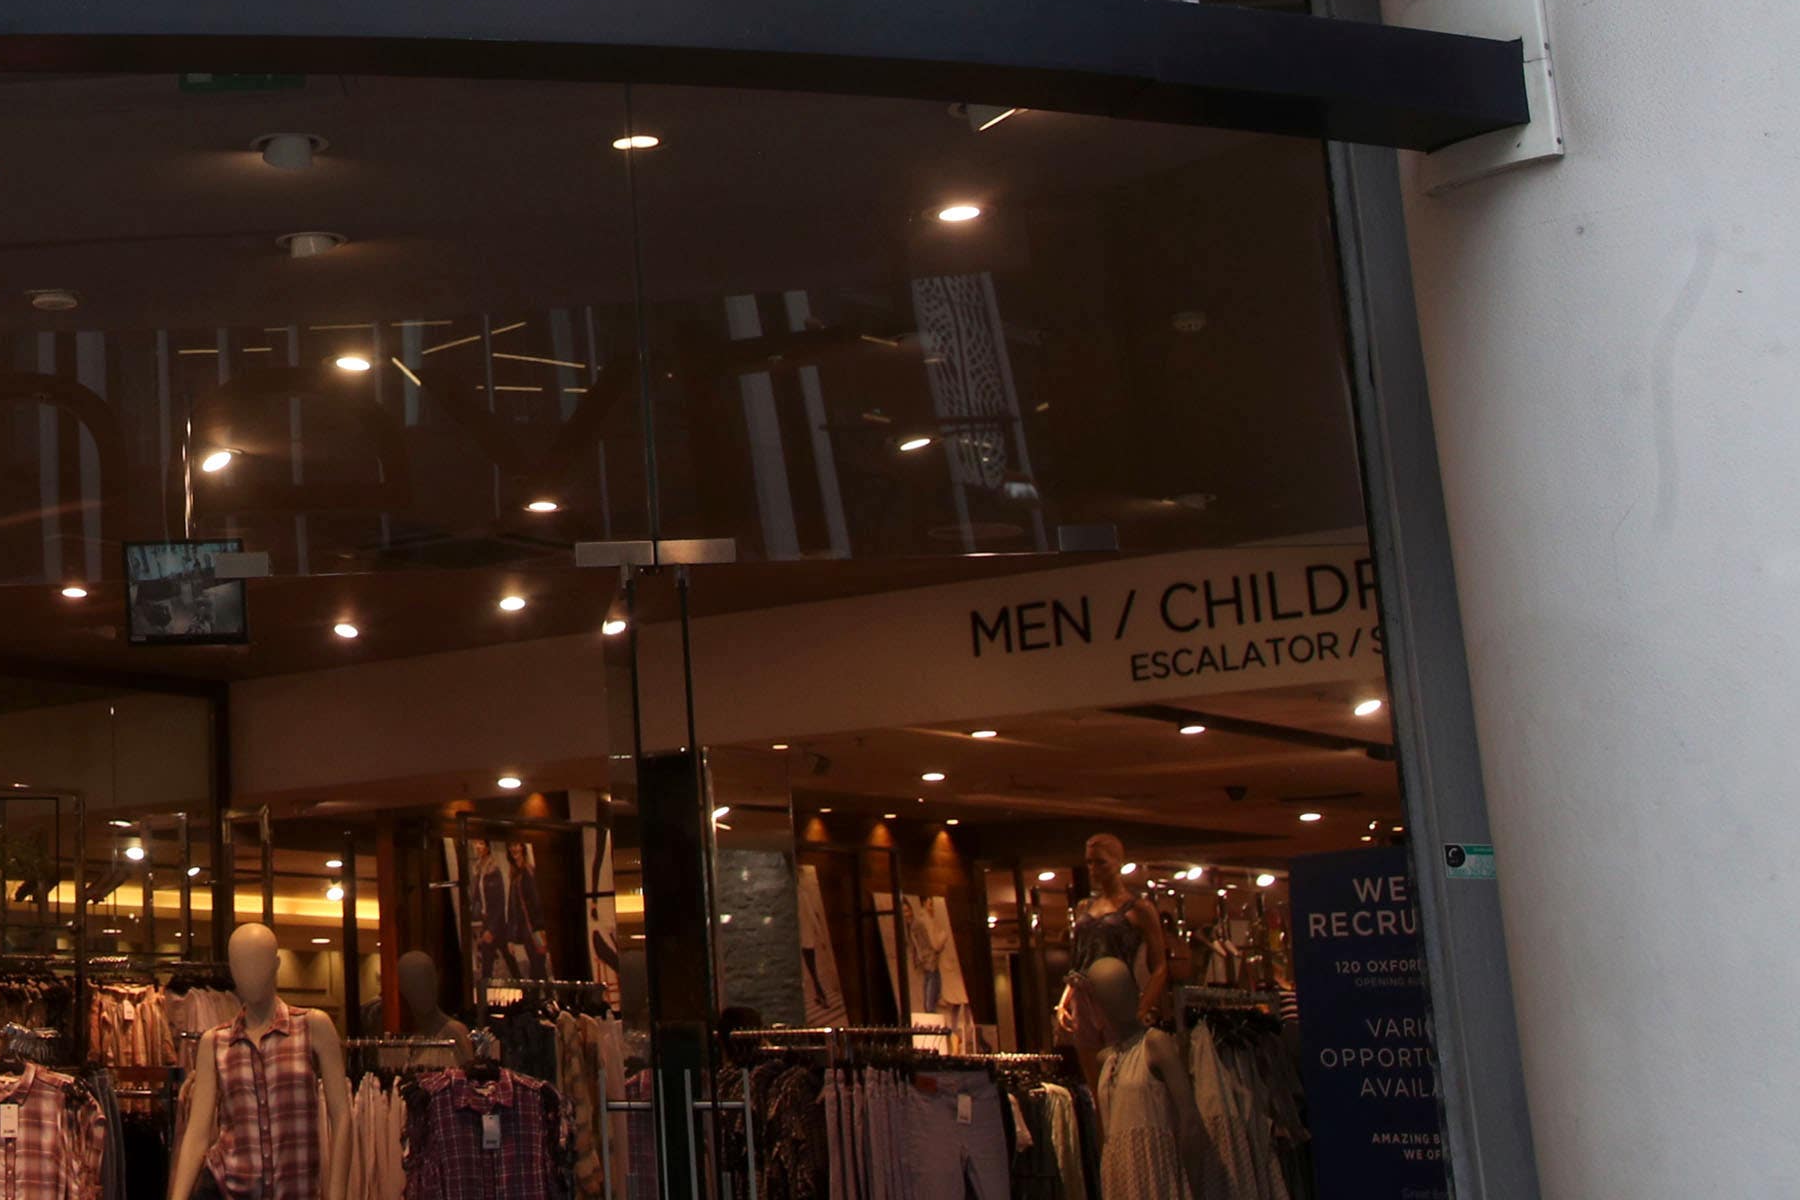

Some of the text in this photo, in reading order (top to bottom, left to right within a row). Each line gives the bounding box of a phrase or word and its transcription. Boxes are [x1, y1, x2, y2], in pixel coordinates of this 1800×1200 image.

[970, 596, 1091, 657] MEN
[1115, 589, 1136, 640] /
[1130, 632, 1339, 682] ESCALATOR
[1348, 628, 1362, 657] /
[1352, 876, 1407, 903] WE
[1308, 908, 1417, 938] RECRU
[1335, 960, 1360, 973] 120
[1365, 1017, 1430, 1039] VARI
[1372, 1132, 1430, 1144] AMAZING
[1403, 1149, 1425, 1161] WE
